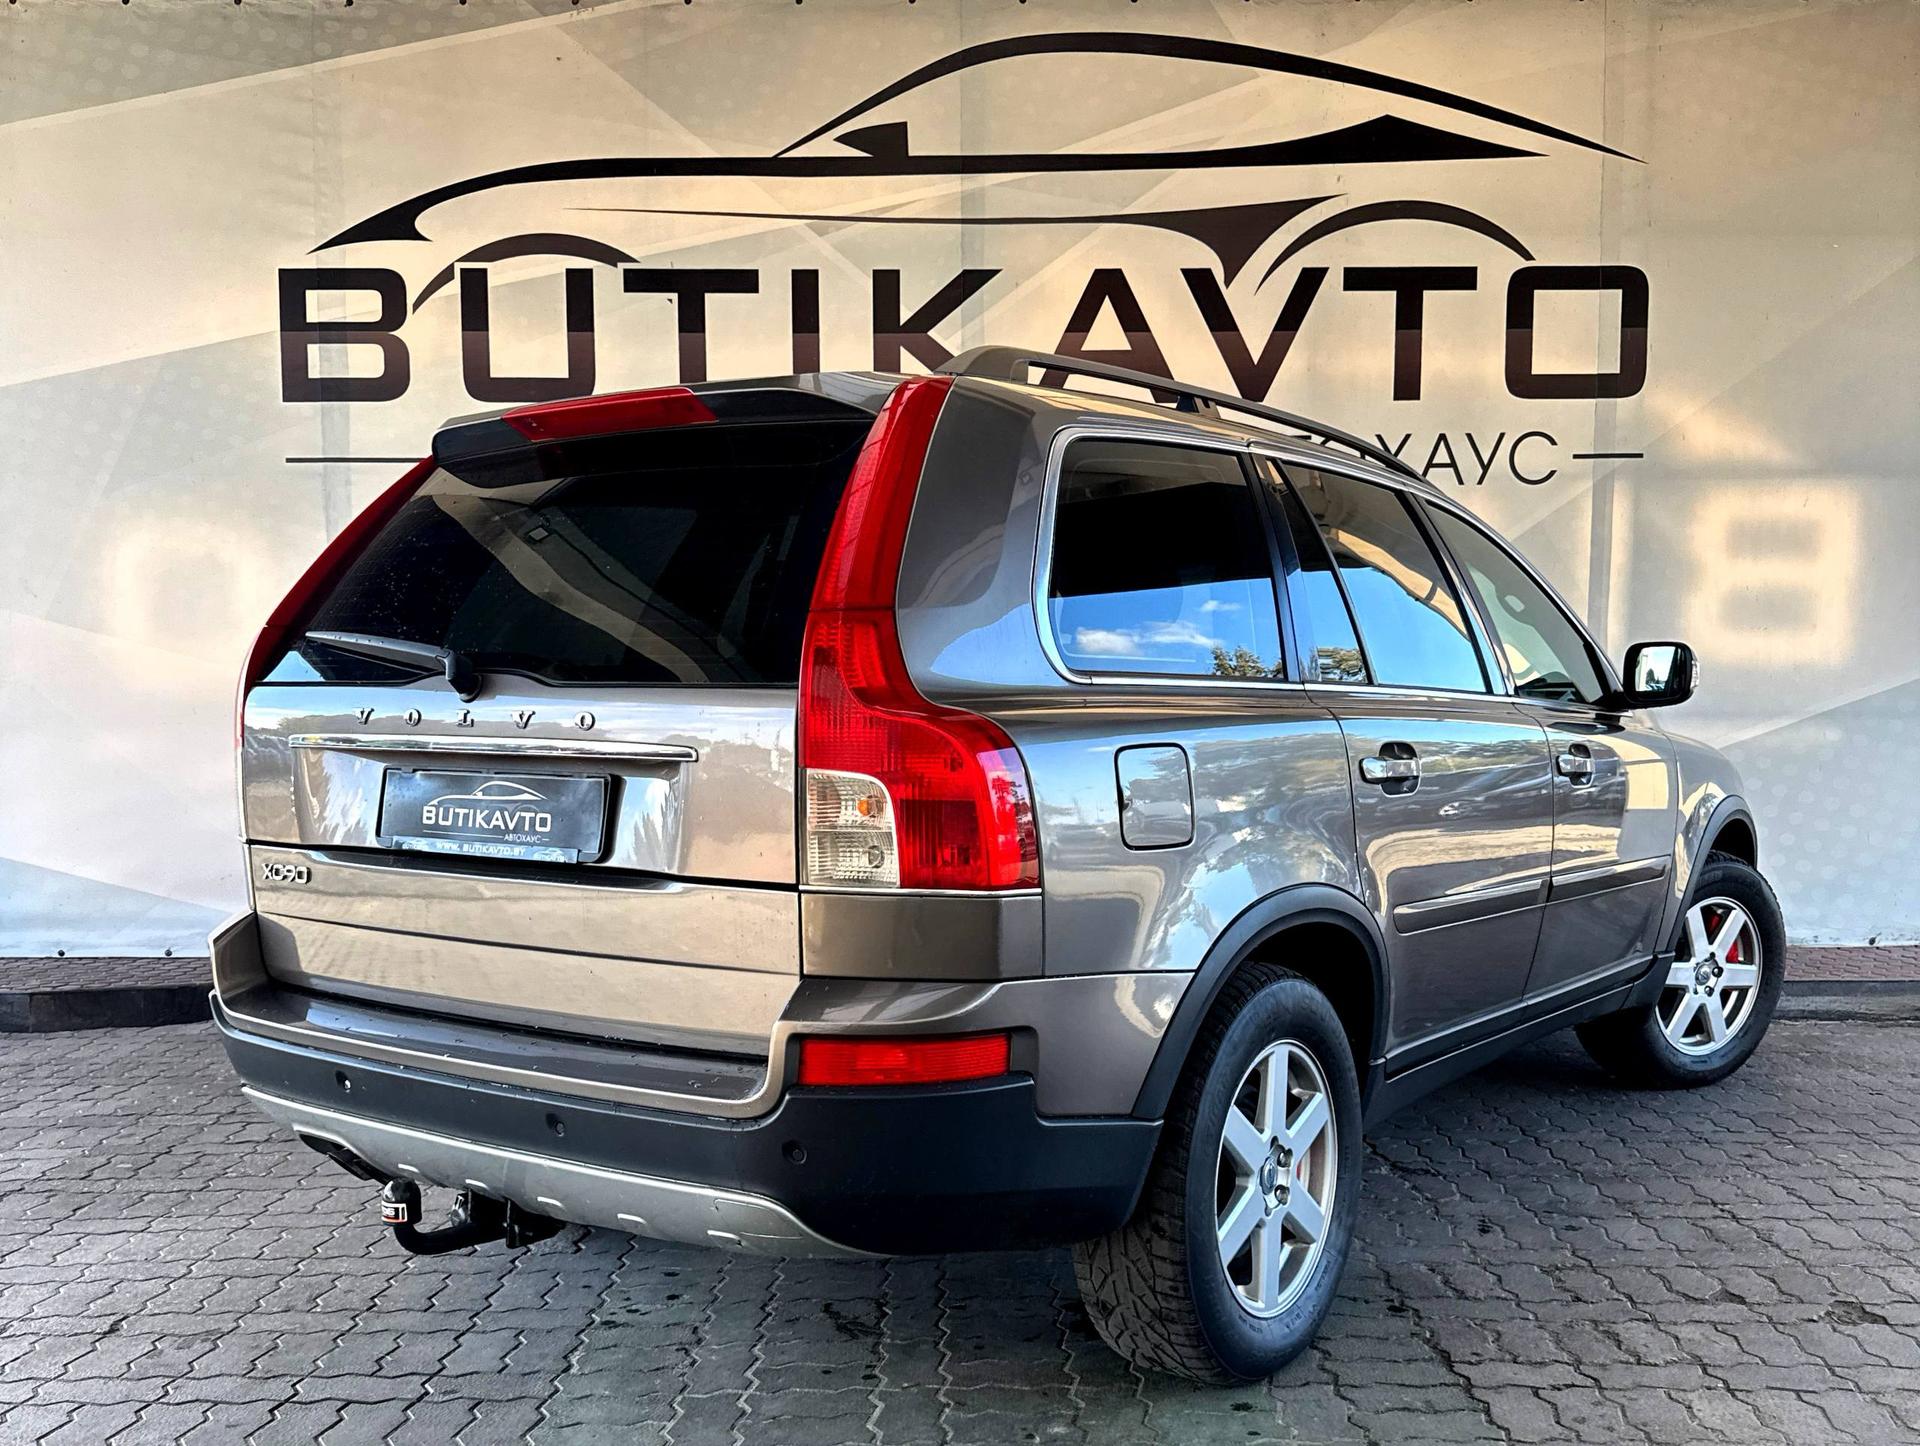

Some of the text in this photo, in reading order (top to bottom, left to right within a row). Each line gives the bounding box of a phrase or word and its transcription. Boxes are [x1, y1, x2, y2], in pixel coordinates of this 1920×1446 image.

[278, 265, 1650, 403] BUTIKAVTO
[353, 706, 597, 732] VOLVO
[422, 805, 552, 833] BUTIKAVTO
[261, 863, 313, 885] XC90
